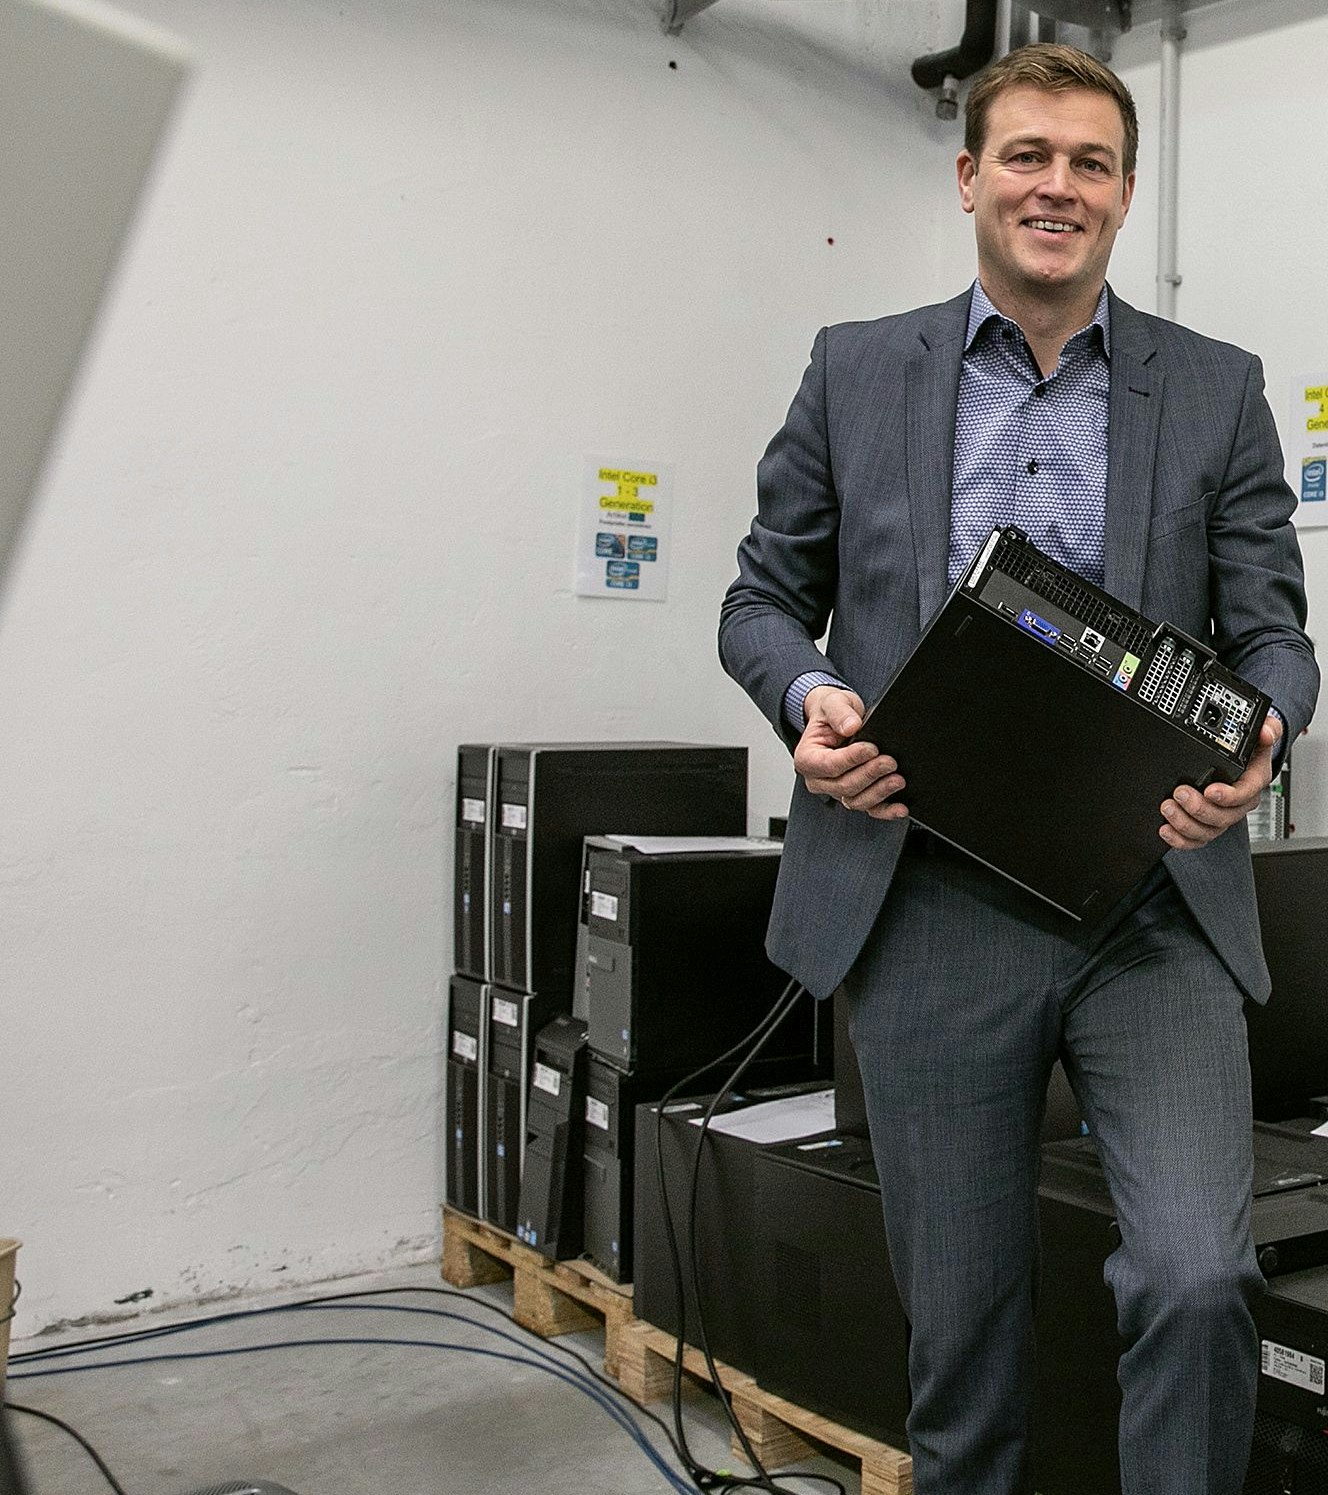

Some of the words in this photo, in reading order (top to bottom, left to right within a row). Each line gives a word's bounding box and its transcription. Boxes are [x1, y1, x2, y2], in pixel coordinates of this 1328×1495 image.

[1305, 387, 1323, 400] Intel
[622, 471, 647, 484] Core
[600, 496, 654, 512] Generation
